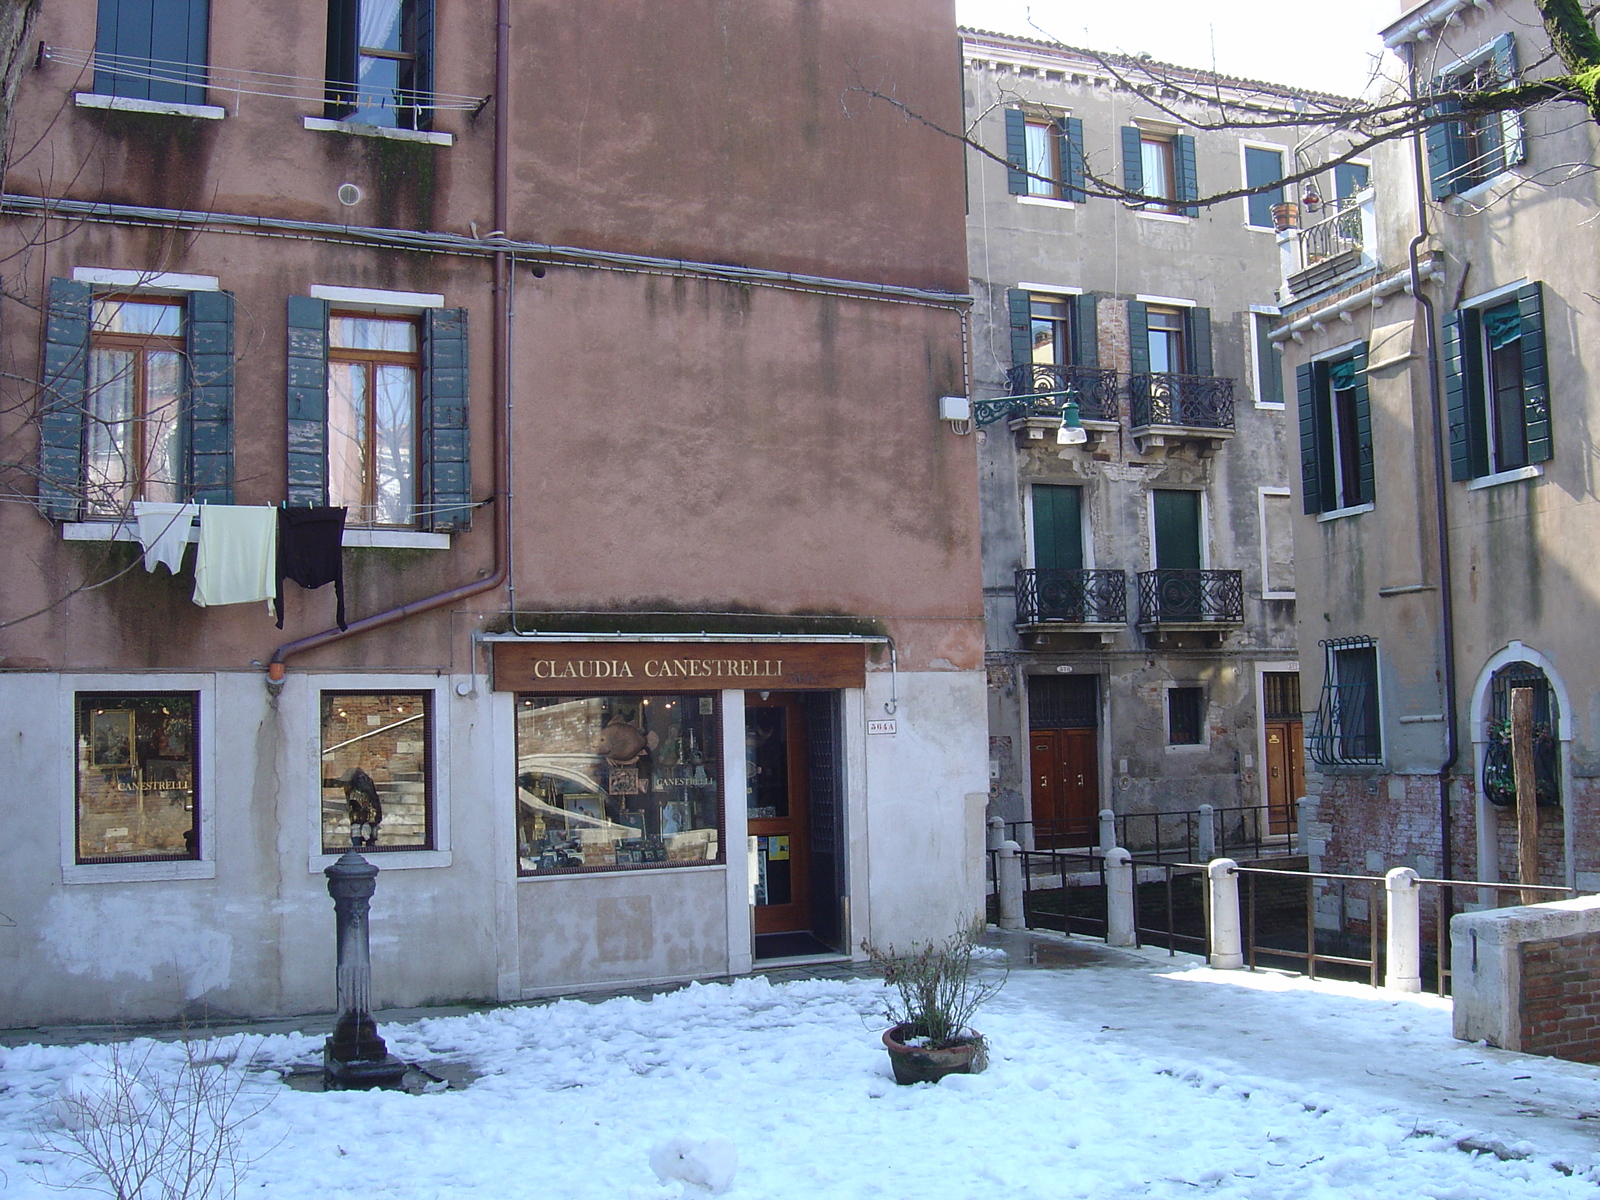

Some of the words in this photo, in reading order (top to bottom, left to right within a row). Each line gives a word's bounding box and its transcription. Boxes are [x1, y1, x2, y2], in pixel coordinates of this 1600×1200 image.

[534, 659, 634, 678] CLAUDIA
[644, 659, 783, 678] CANESTRELLI
[117, 780, 188, 792] CANESTRELLI
[656, 777, 713, 787] CANESTRELLI
